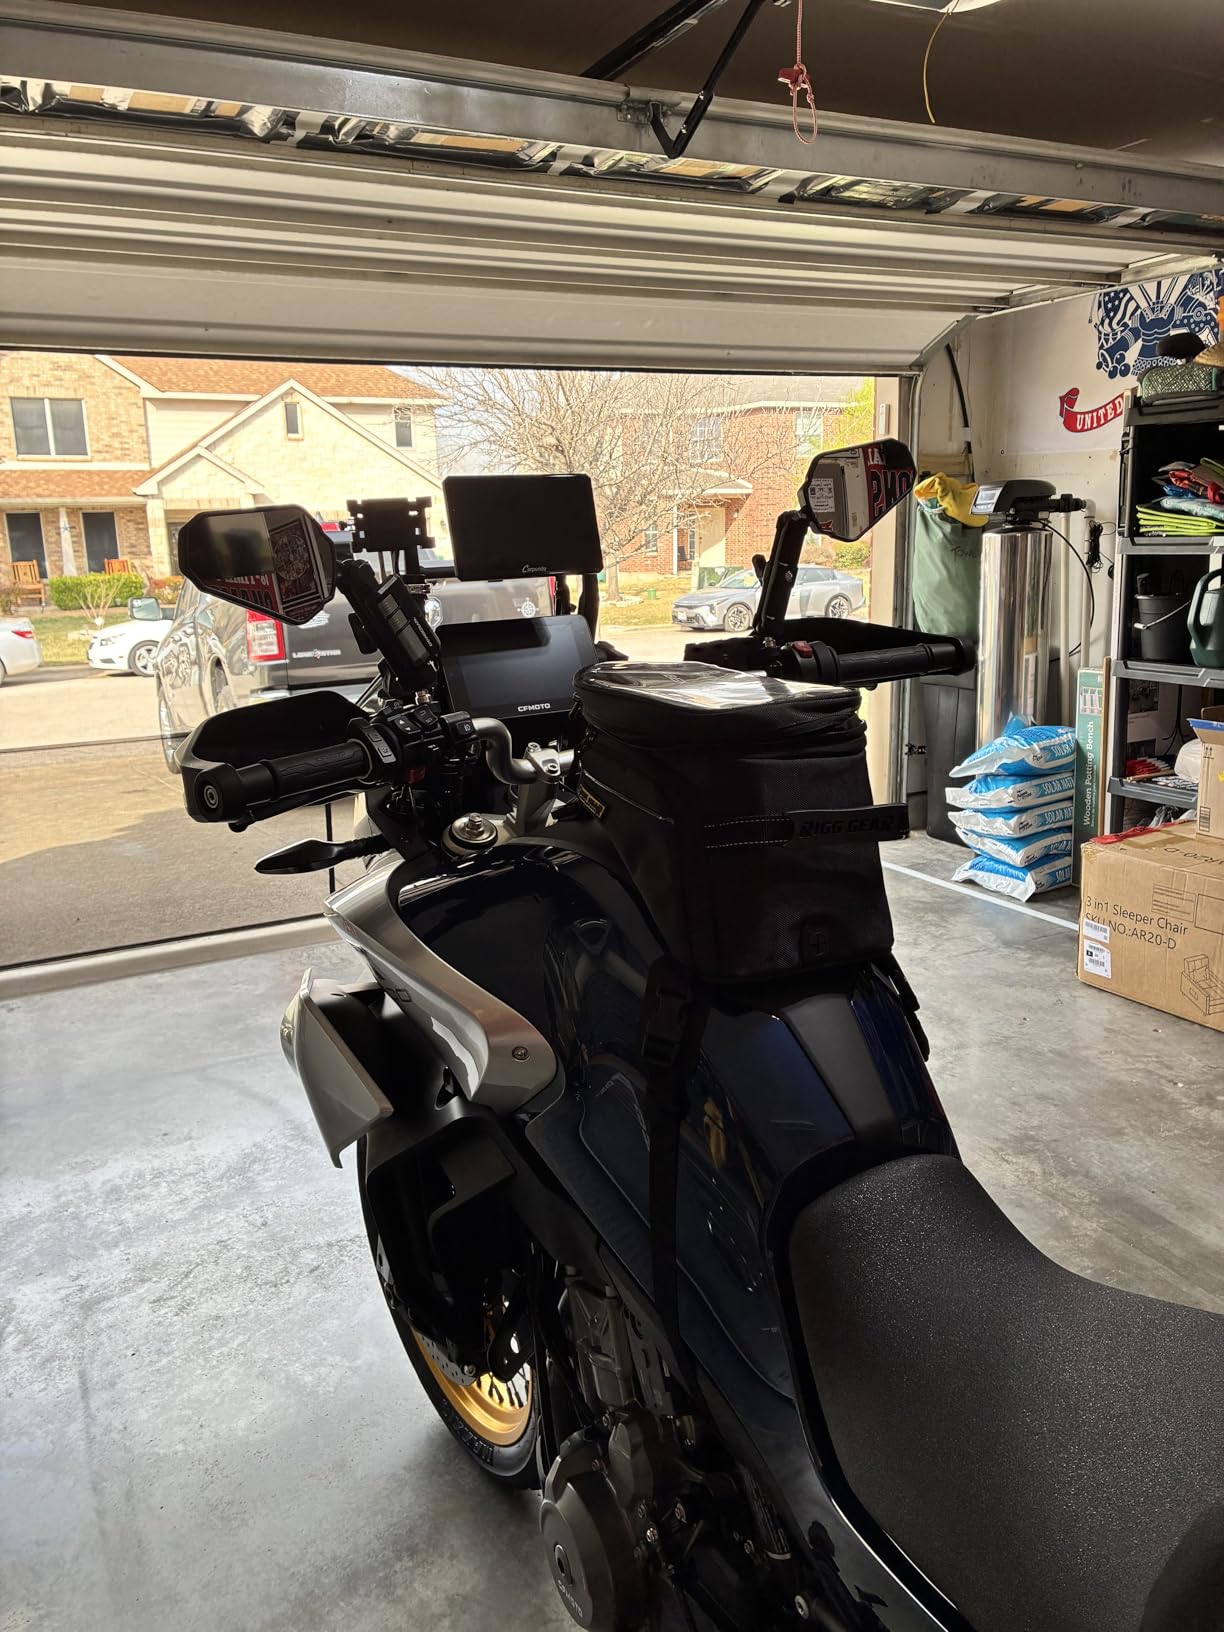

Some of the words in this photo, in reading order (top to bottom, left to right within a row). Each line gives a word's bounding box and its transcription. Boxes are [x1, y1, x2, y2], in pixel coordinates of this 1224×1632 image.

[1076, 396, 1123, 430] UNITED
[517, 703, 551, 712] CFMOTO
[1086, 721, 1095, 750] Bench
[1085, 750, 1094, 788] Potting
[1042, 780, 1062, 795] SOLAR
[1044, 809, 1063, 824] SOLAR
[1083, 790, 1092, 826] Wooden
[799, 820, 846, 835] RIGG
[847, 815, 894, 832] GEAR
[1086, 895, 1092, 907] 3
[1094, 899, 1109, 912] in1
[1112, 904, 1154, 926] Sleeper
[1156, 917, 1188, 935] Chair
